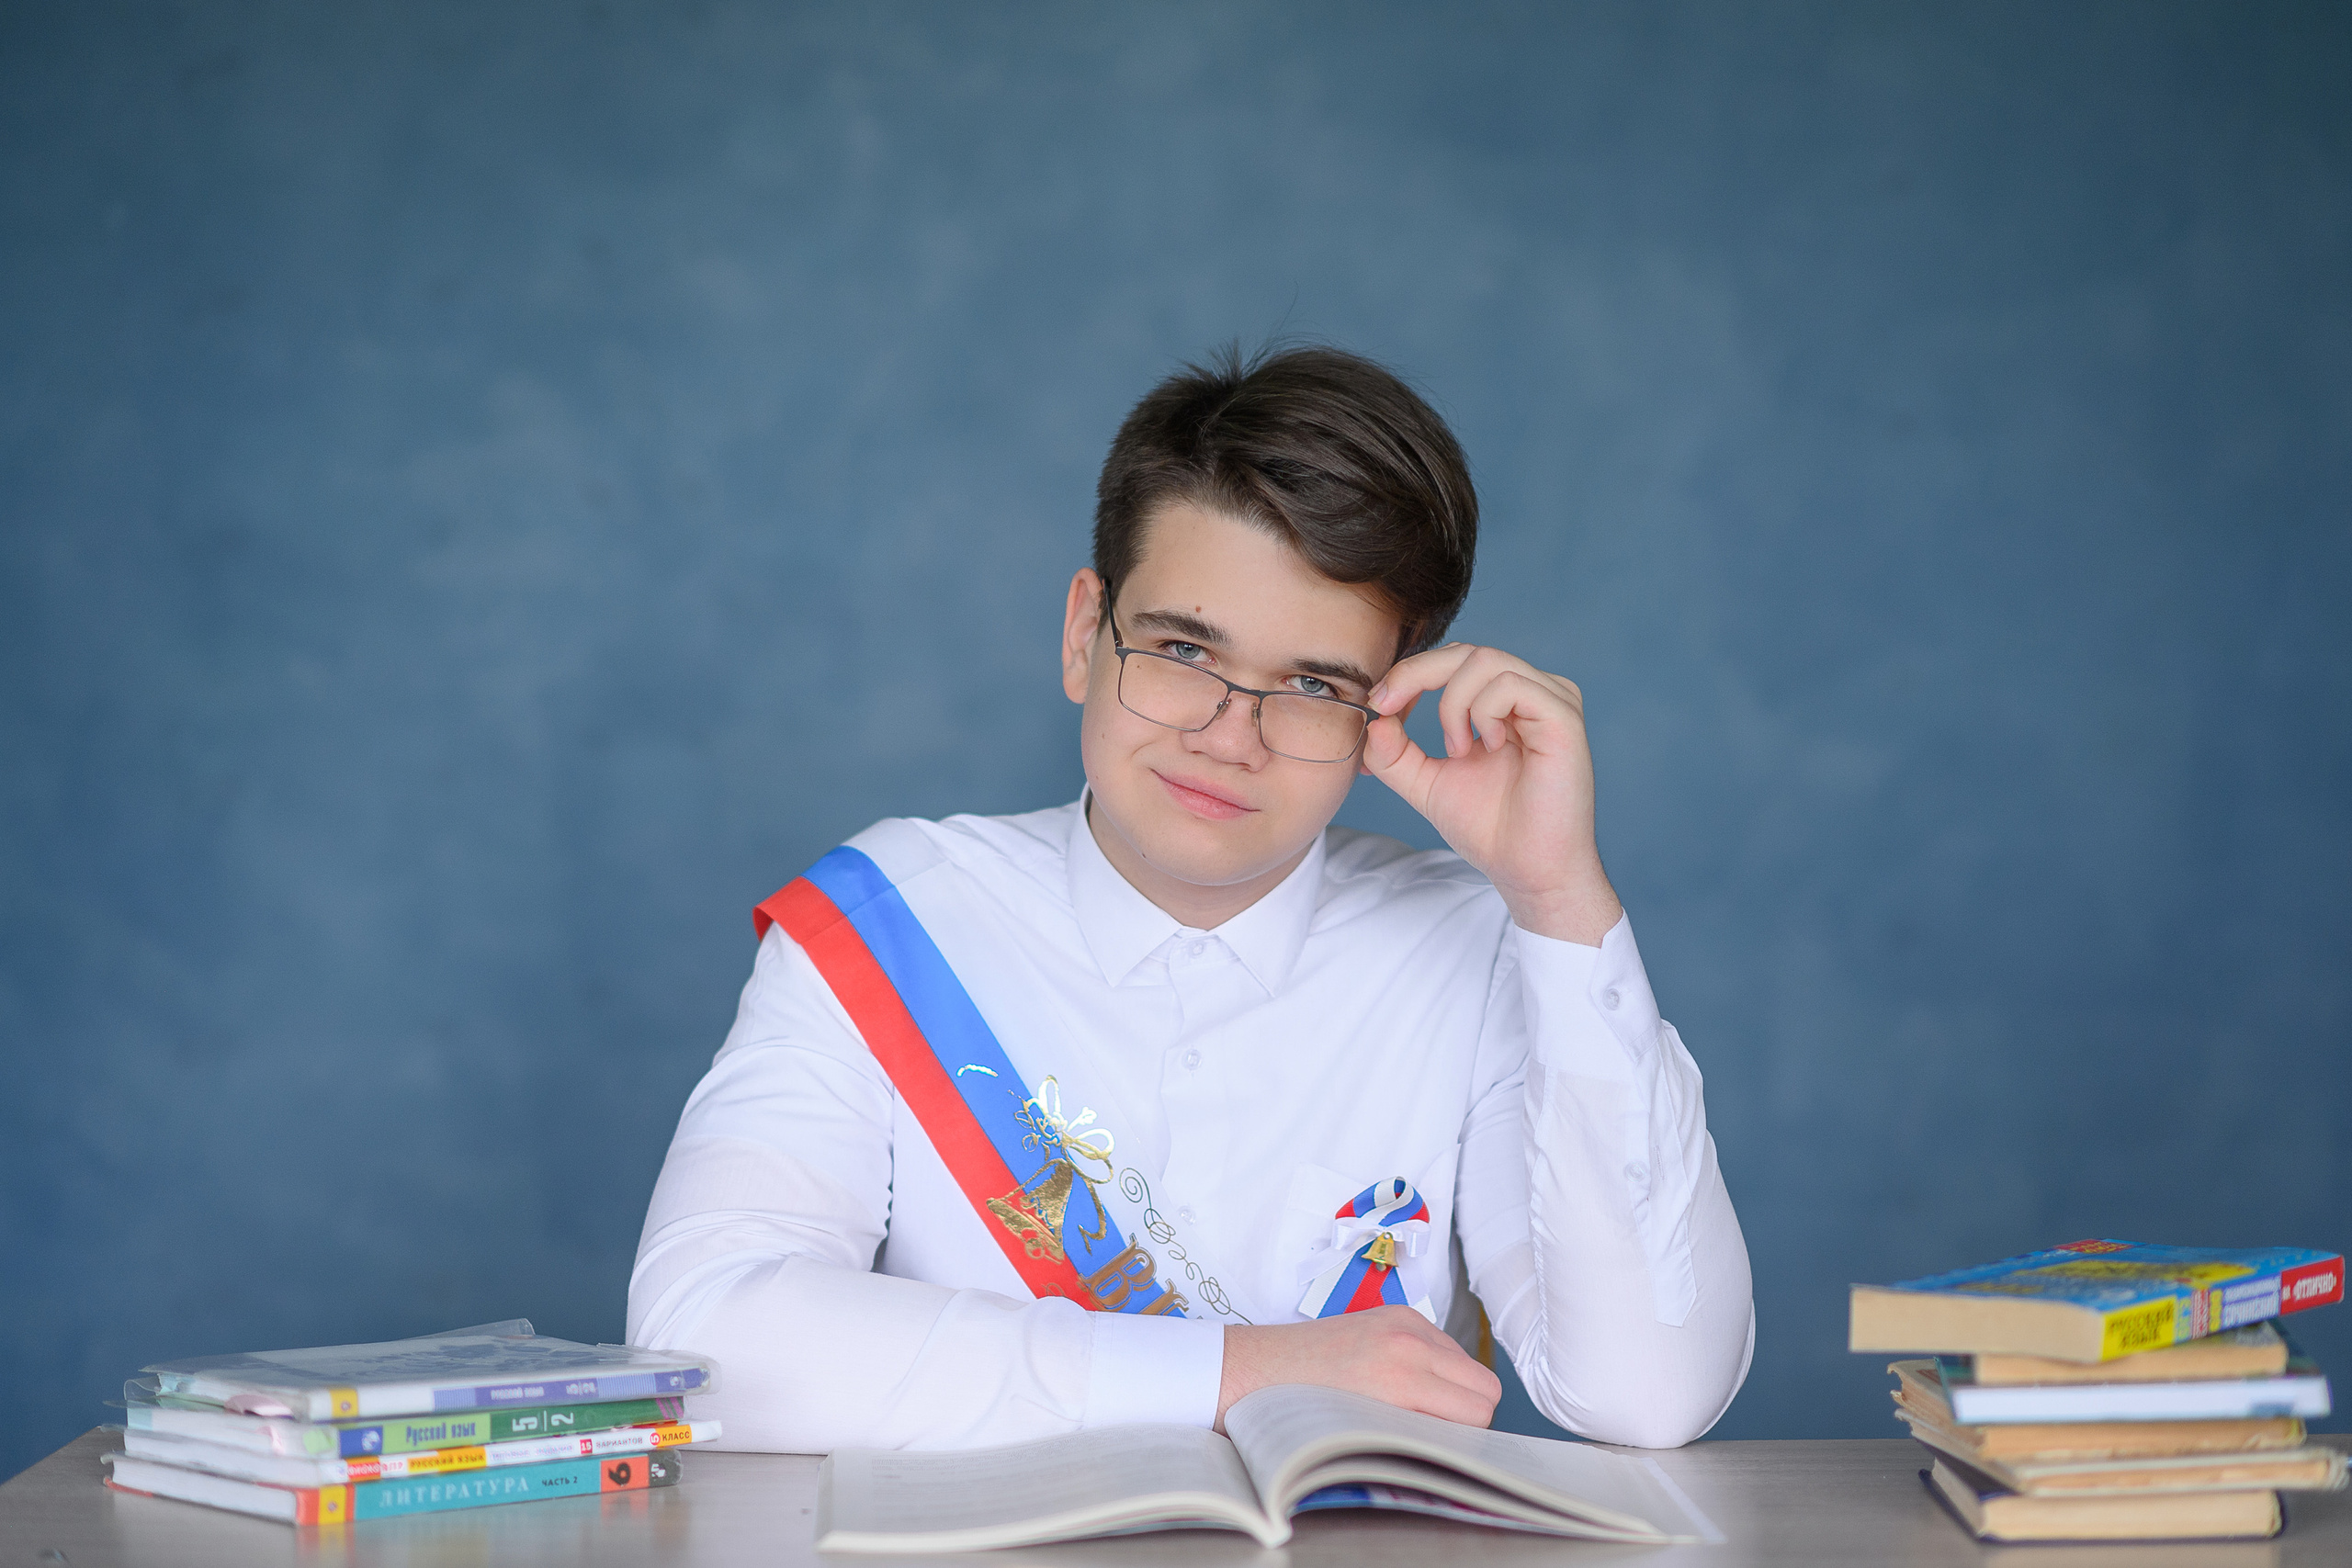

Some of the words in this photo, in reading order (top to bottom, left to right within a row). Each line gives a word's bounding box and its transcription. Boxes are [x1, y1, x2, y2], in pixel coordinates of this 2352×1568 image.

[405, 1423, 447, 1446] Русский
[410, 1456, 454, 1469] РУССКИЙ
[458, 1453, 486, 1465] ЯЗЫК
[580, 1441, 593, 1451] 15
[595, 1437, 643, 1449] ВАРИАНТОВ
[662, 1430, 690, 1442] КЛАСС
[379, 1476, 529, 1508] ЛИТЕРАТУРА
[541, 1476, 570, 1487] ЧАСТЬ
[572, 1475, 579, 1484] 2
[608, 1461, 631, 1486] 6
